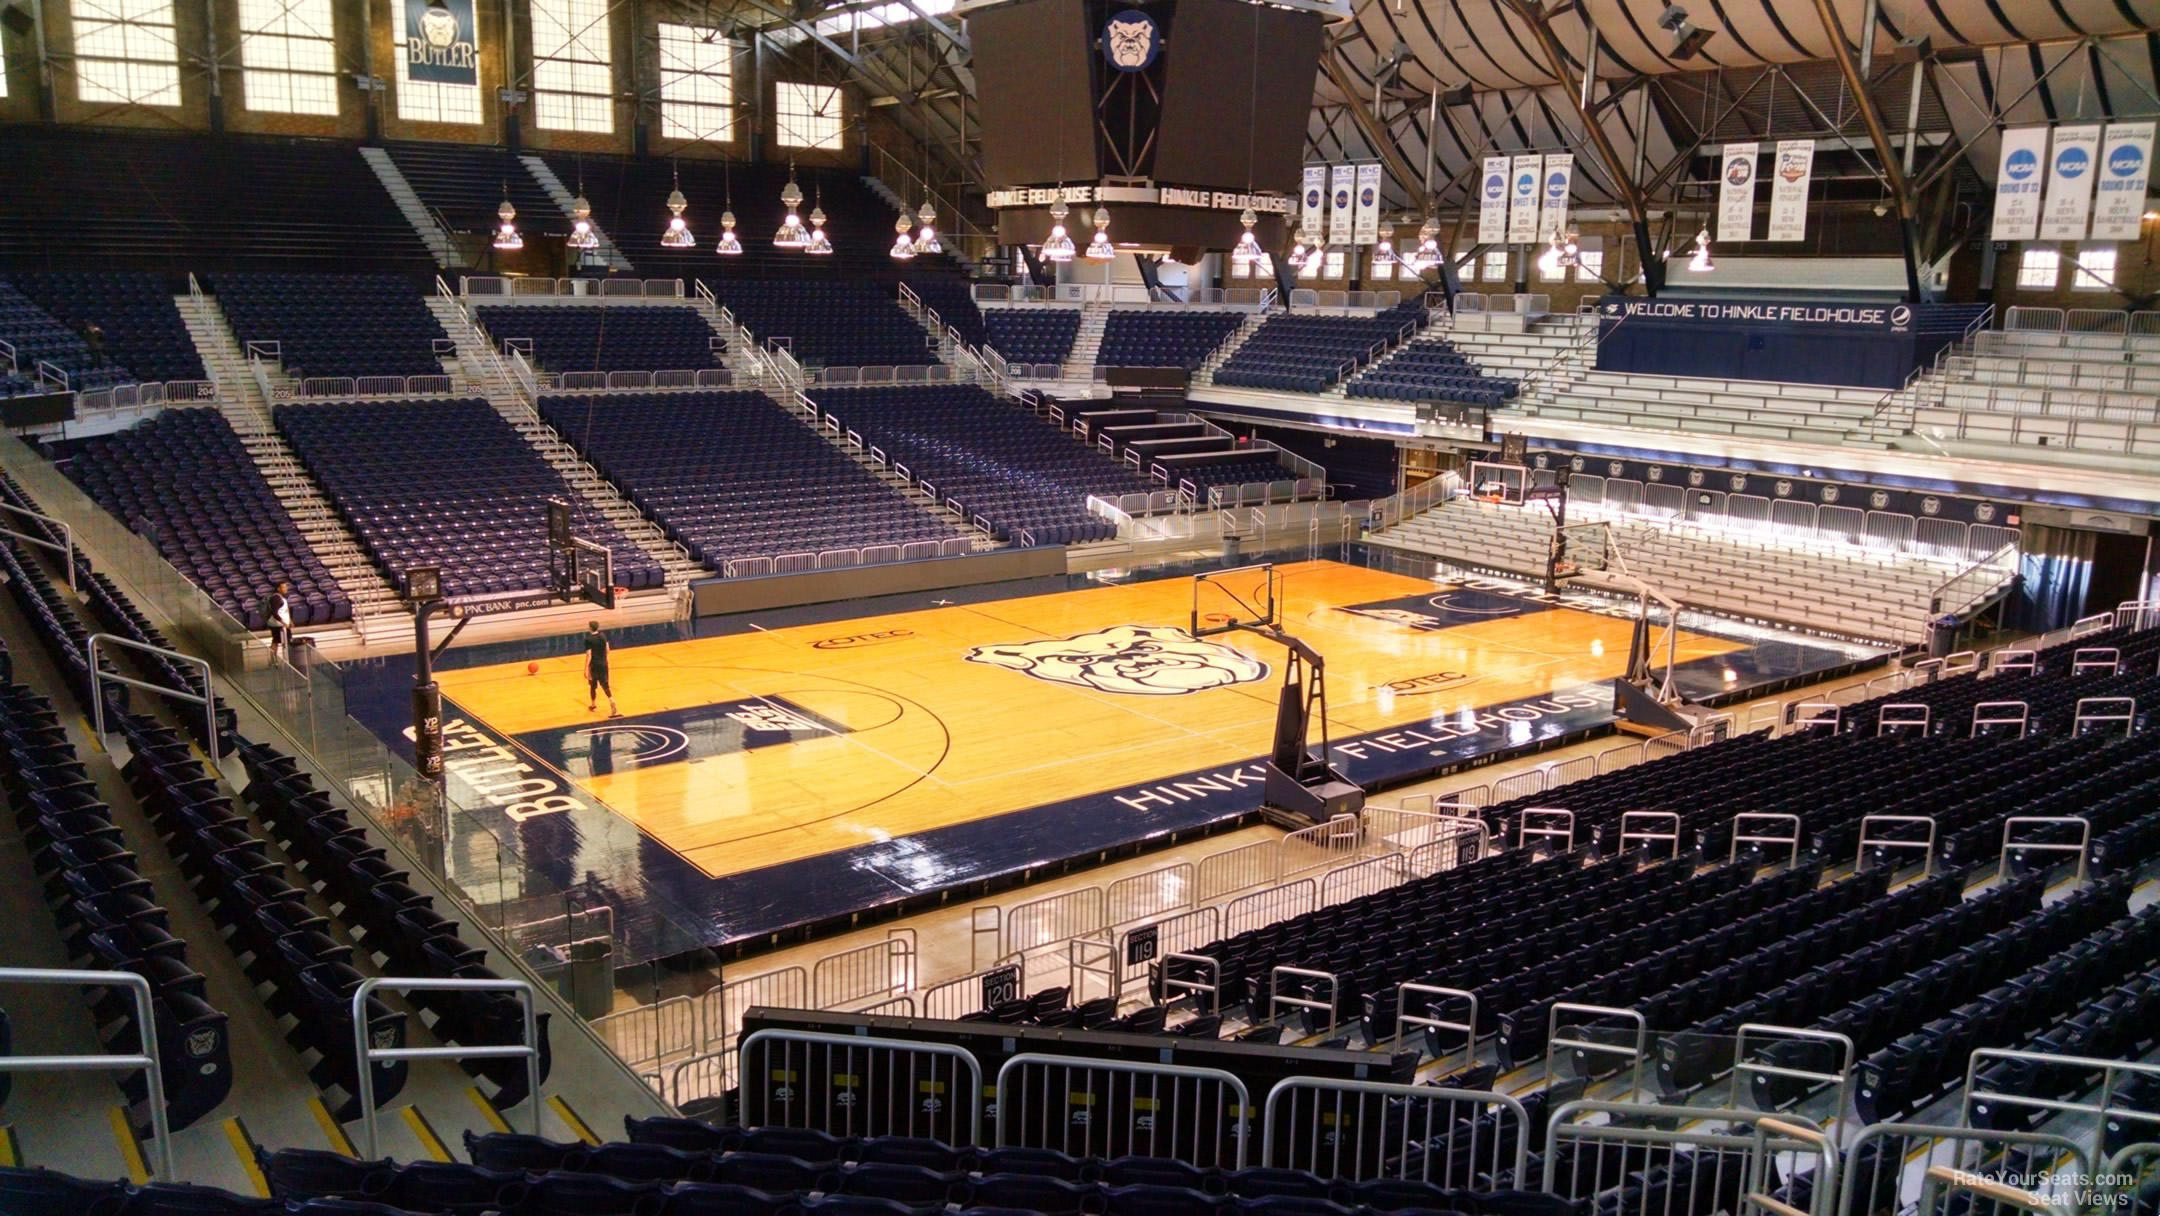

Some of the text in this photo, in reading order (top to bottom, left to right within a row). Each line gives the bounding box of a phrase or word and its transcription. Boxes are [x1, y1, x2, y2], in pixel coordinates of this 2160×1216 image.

[408, 37, 474, 69] BUTLER
[2008, 164, 2036, 172] NCAA
[2058, 162, 2087, 172] NCAA
[2110, 159, 2142, 169] NCAA
[992, 190, 1028, 206] HINKLE
[1160, 187, 1210, 207] HINKLE
[1996, 216, 2034, 224] BASKETBALL
[2044, 216, 2084, 224] BASKETBALL
[2096, 216, 2139, 224] BASKETBALL
[1994, 242, 2008, 250] 213
[1624, 302, 1885, 324] WELCOME TO HINKLE FIELDHOUSE
[197, 387, 214, 396] 204
[274, 390, 290, 398] 205
[515, 599, 549, 610] pnc.com
[1334, 688, 1616, 760] FIELDHOUSE
[1462, 844, 1476, 862] 119
[1130, 930, 1157, 944] SECTION
[1135, 940, 1152, 962] 119
[985, 972, 1016, 988] SECTION
[988, 982, 1014, 1006] 120
